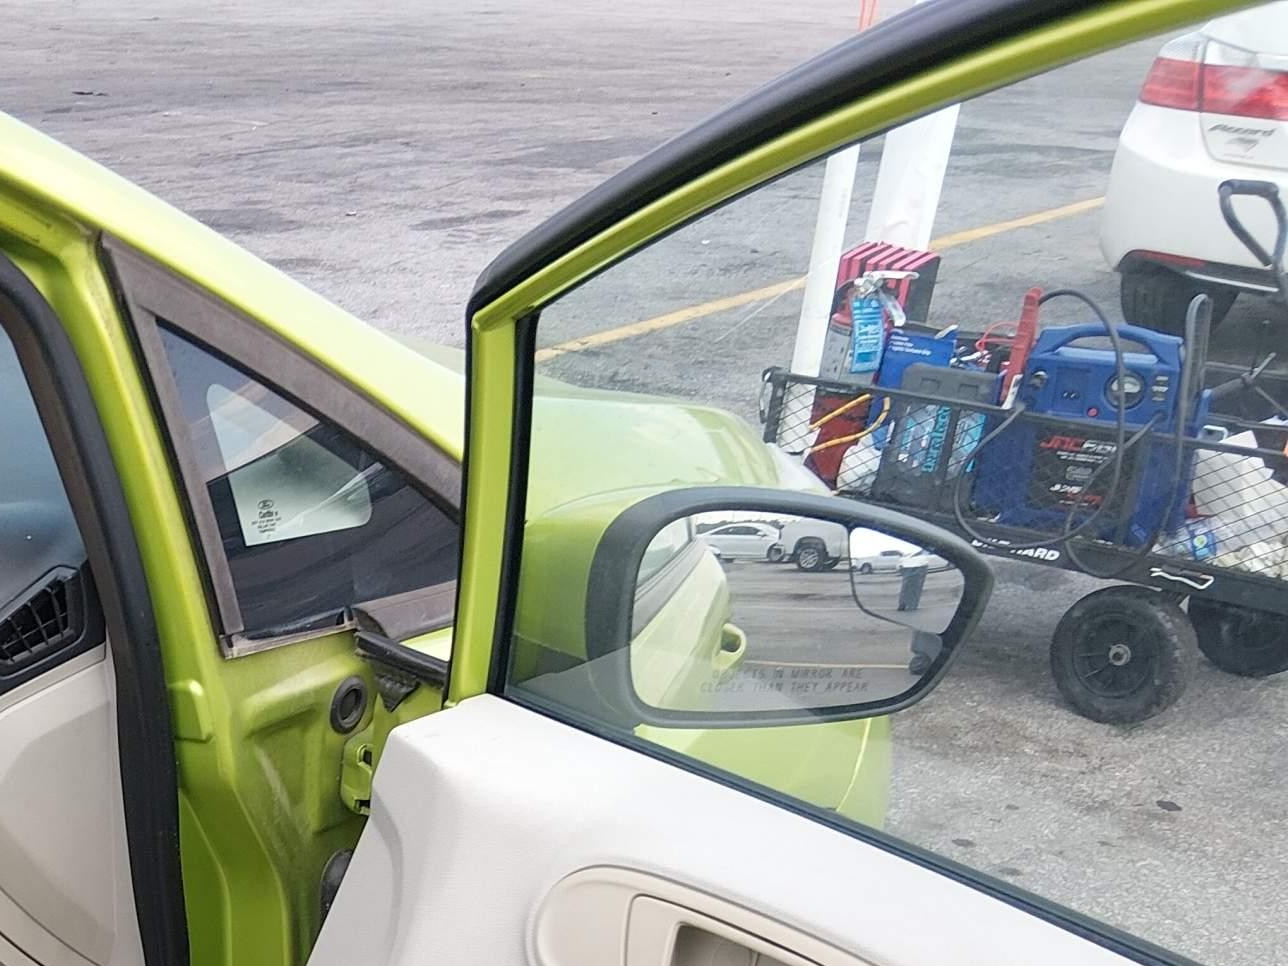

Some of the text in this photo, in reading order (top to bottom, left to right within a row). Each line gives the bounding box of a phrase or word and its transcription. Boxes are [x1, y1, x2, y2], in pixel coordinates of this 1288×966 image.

[791, 668, 833, 680] MIRROR
[841, 667, 865, 679] ARE
[752, 682, 784, 693] THAN
[792, 682, 819, 693] THEY
[825, 681, 868, 693] APPEAR
